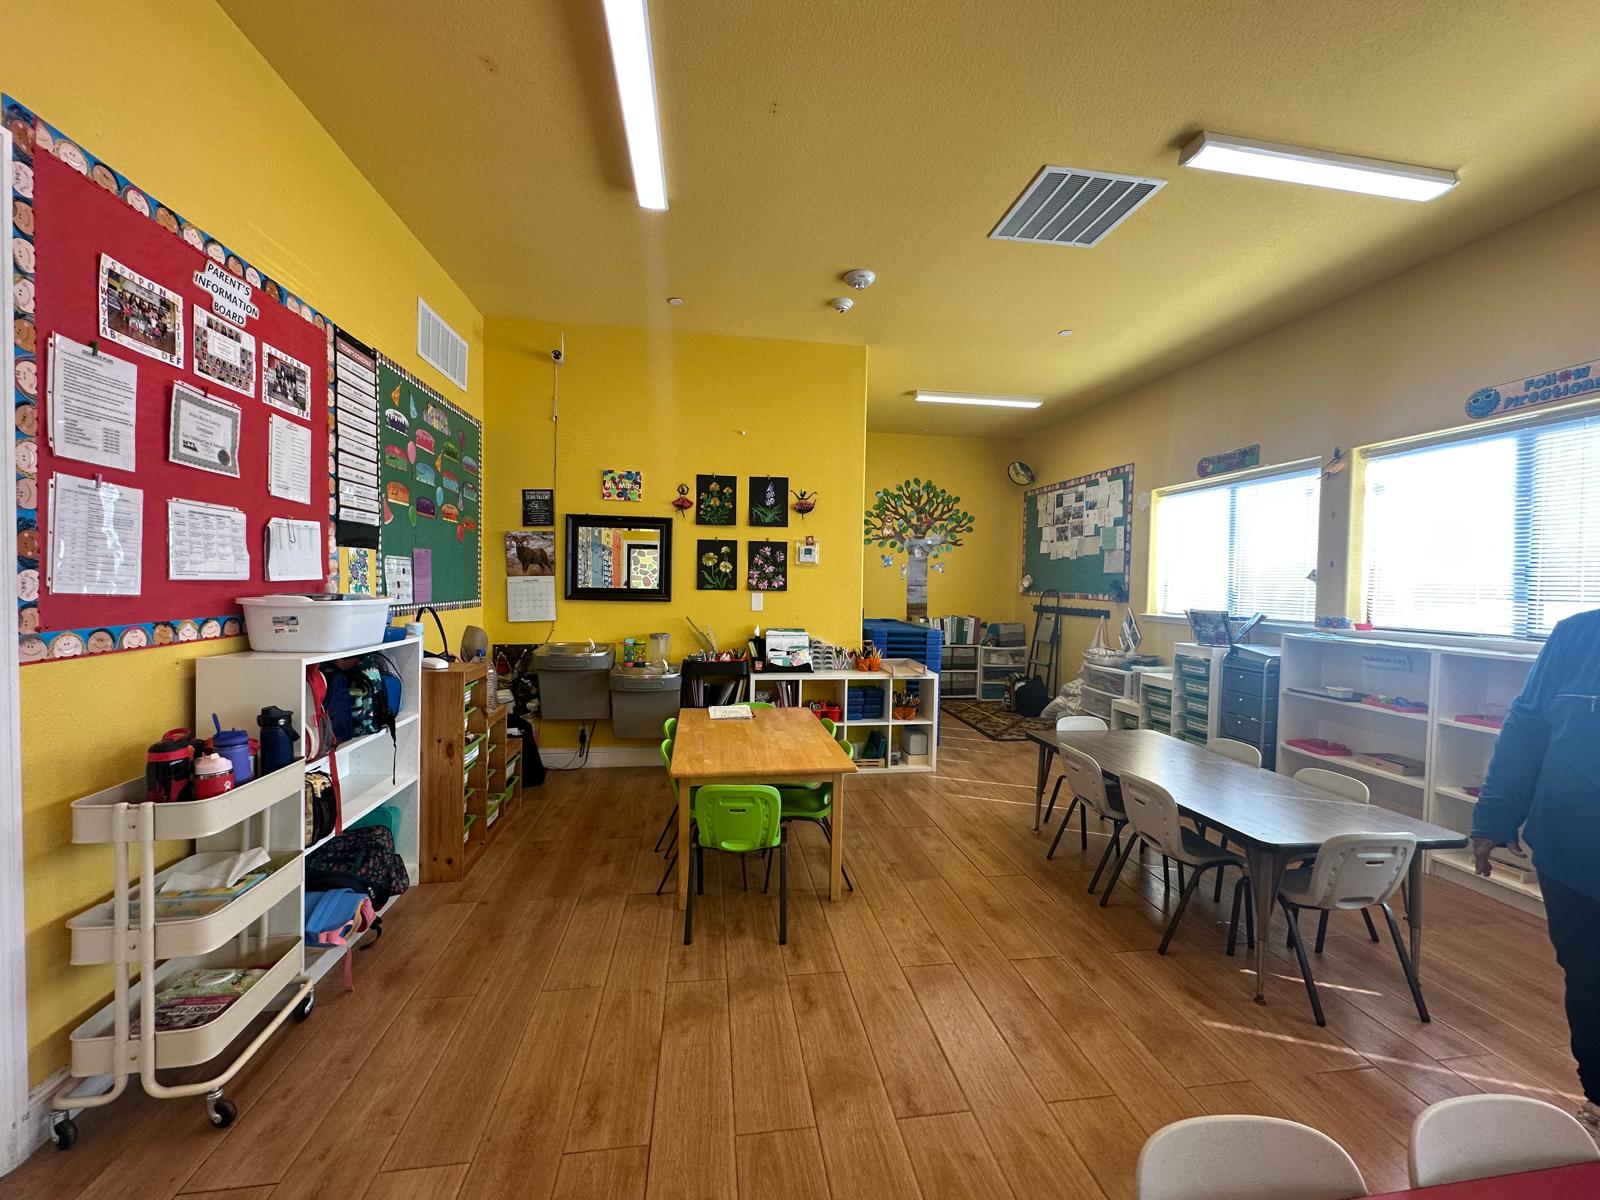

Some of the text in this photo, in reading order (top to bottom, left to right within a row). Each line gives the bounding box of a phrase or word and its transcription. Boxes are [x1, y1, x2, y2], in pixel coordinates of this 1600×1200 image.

[208, 263, 250, 296] PARENT'S
[195, 273, 258, 317] INFORMATION
[214, 301, 244, 325] BOARD
[1524, 366, 1591, 392] Follow
